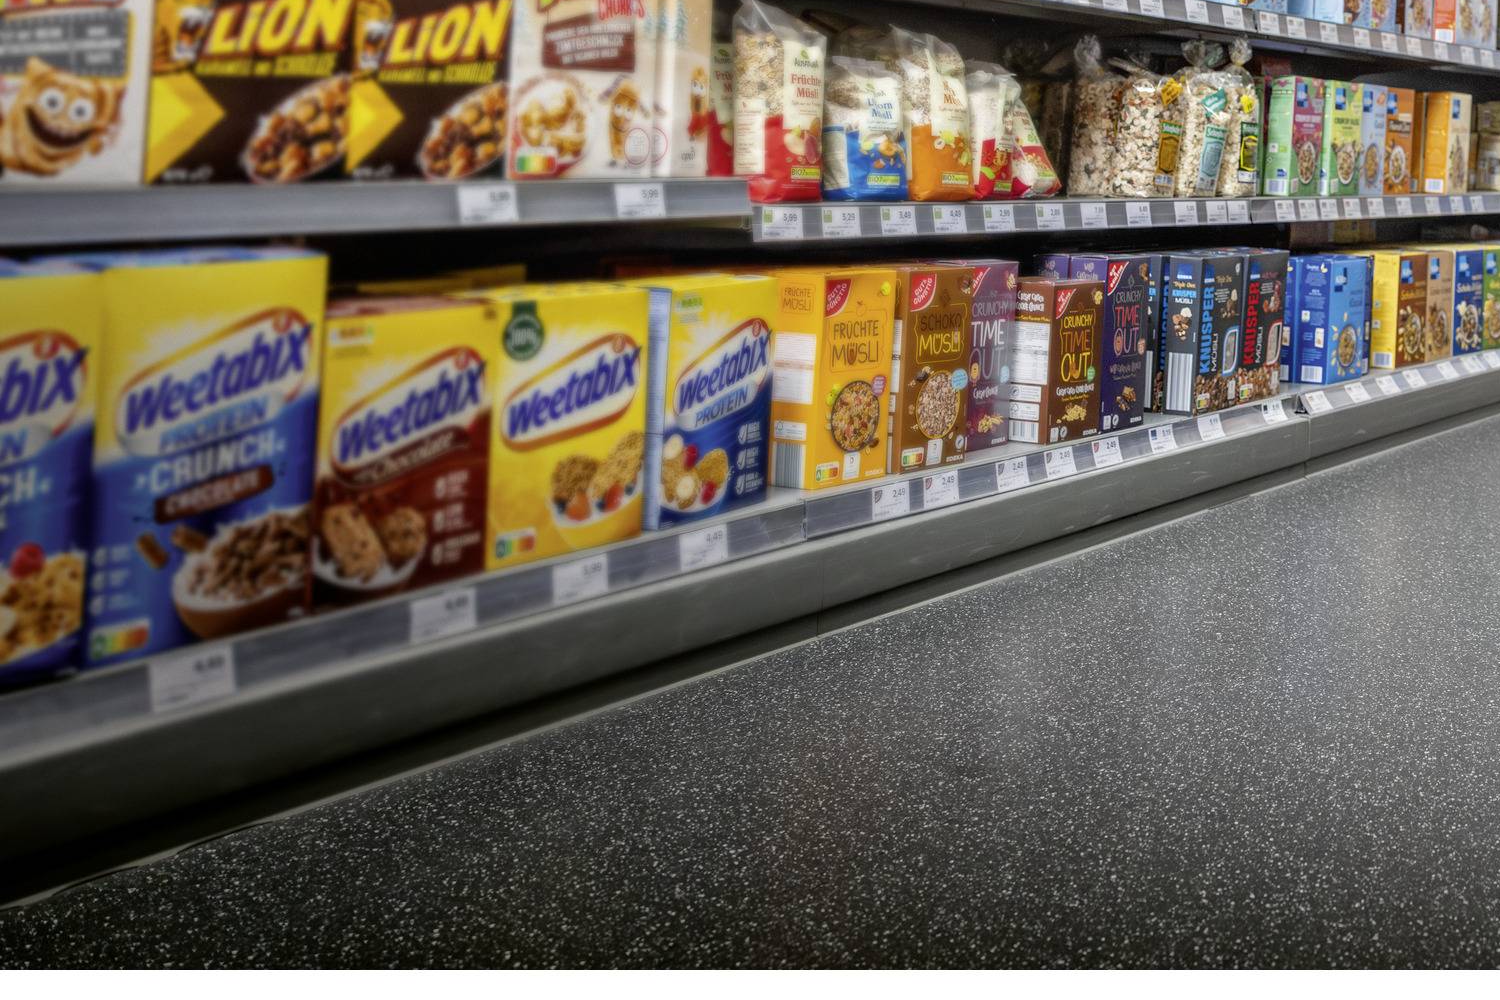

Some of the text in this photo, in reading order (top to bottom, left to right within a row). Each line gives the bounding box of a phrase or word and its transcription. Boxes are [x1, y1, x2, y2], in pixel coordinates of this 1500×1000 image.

[971, 300, 1010, 317] CRUNCHY
[1115, 289, 1143, 304] CRUNCHY
[833, 319, 879, 339] FRÜCHTE
[920, 311, 962, 332] SCHOKO
[1063, 313, 1094, 329] CRUNCHY
[1114, 304, 1140, 329] TIME
[1200, 286, 1216, 375] KNUSPER
[1243, 281, 1261, 365] KNUSPER
[919, 331, 961, 357] MÜSLI
[971, 318, 1006, 348] TIME
[1062, 329, 1091, 351] TIME
[1113, 326, 1140, 358] OUT
[1255, 326, 1263, 364] MÜSLI
[832, 343, 879, 367] MÜSLI
[968, 347, 1008, 380] OUT
[1061, 351, 1091, 382] OUT
[1211, 332, 1219, 372] MÜSLI
[0, 346, 89, 424] bix
[123, 323, 314, 434] Weetabix
[678, 329, 773, 413] Weetabix
[508, 345, 641, 440] Weetabix
[694, 386, 750, 429] PROTEIN
[336, 359, 487, 463] Weetabix
[149, 429, 277, 493] CRUNCH
